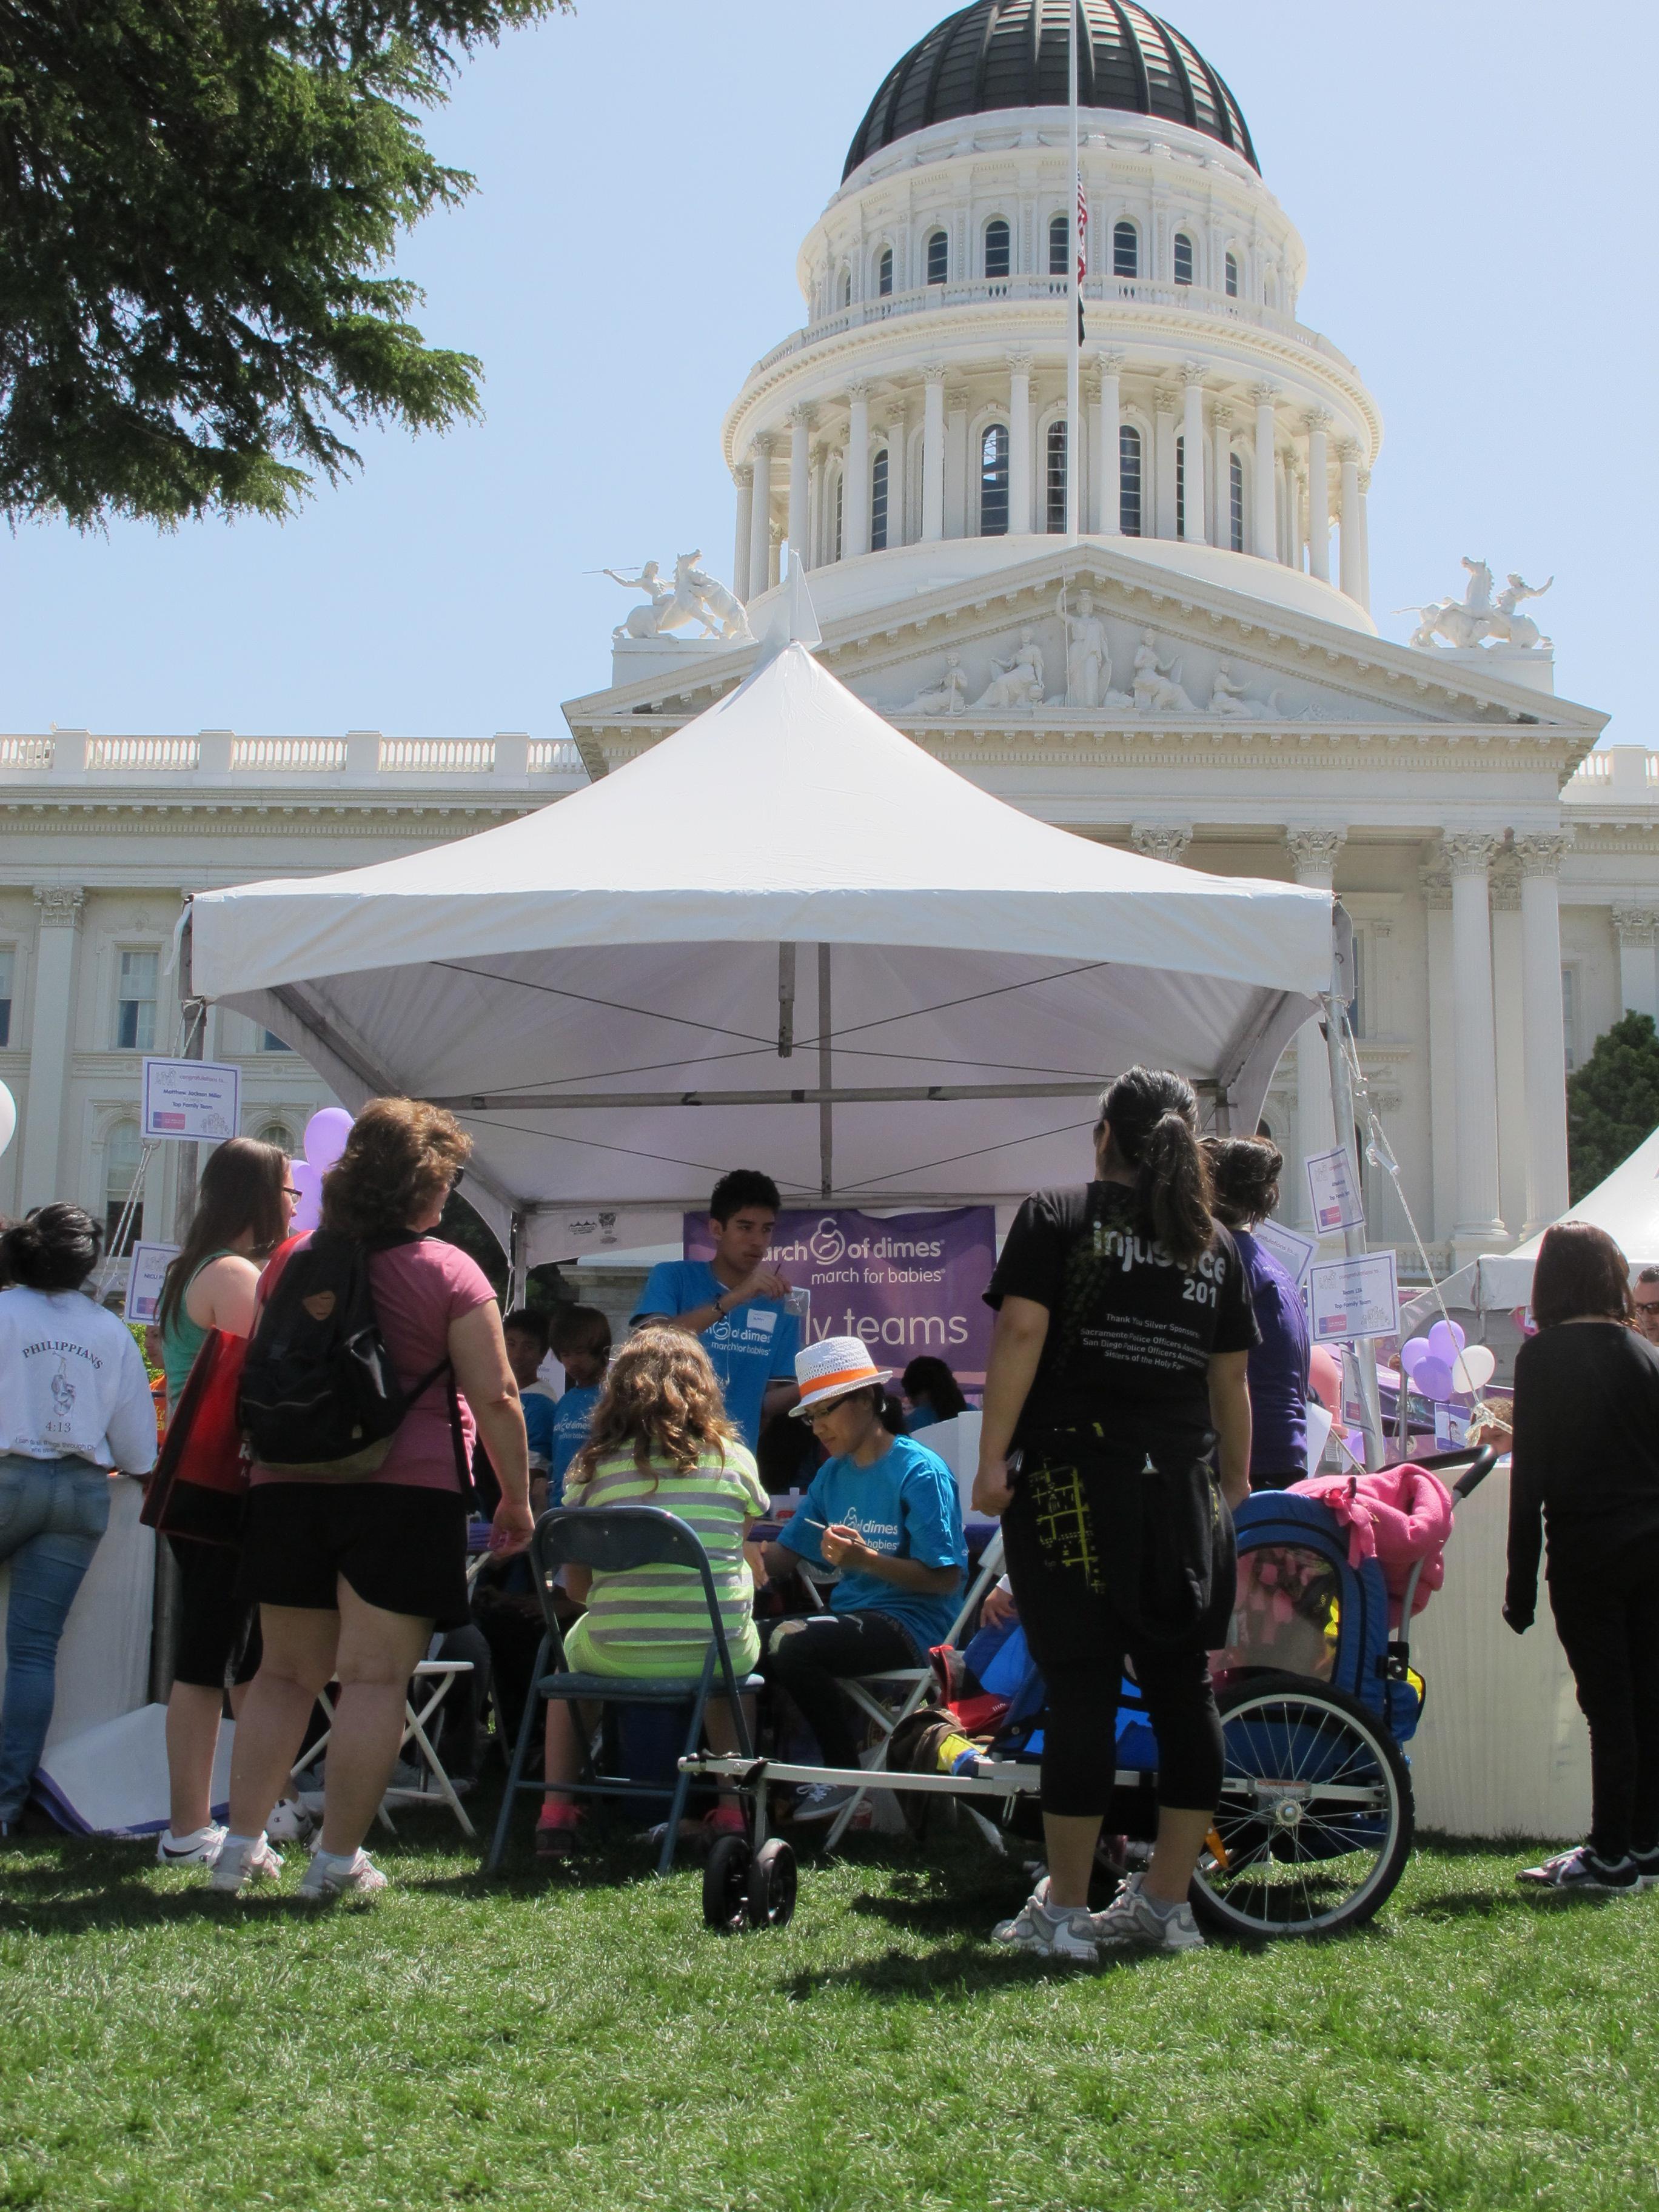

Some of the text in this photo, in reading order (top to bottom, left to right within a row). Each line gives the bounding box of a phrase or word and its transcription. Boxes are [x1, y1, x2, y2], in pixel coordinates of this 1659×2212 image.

[848, 1238, 870, 1259] of
[811, 1267, 859, 1285] march
[863, 1268, 885, 1284] for
[843, 1308, 968, 1345] teams
[1106, 1313, 1130, 1323] Thank
[1132, 1317, 1143, 1327] You
[1144, 1320, 1167, 1330] Silver
[711, 1341, 736, 1351] march
[1080, 1328, 1128, 1339] Sacramento
[1129, 1333, 1151, 1344] Police
[1153, 1337, 1181, 1349] Officers
[22, 1341, 103, 1369] PHILIPPIANS
[1082, 1338, 1098, 1347] San
[1101, 1339, 1122, 1350] Diego
[1123, 1342, 1145, 1353] Police
[1148, 1346, 1176, 1358] Officers
[1104, 1350, 1130, 1361] Sisters
[1155, 1358, 1171, 1369] Holy
[45, 1421, 71, 1432] 4:13
[62, 1442, 86, 1450] through
[862, 1520, 897, 1535] dimes
